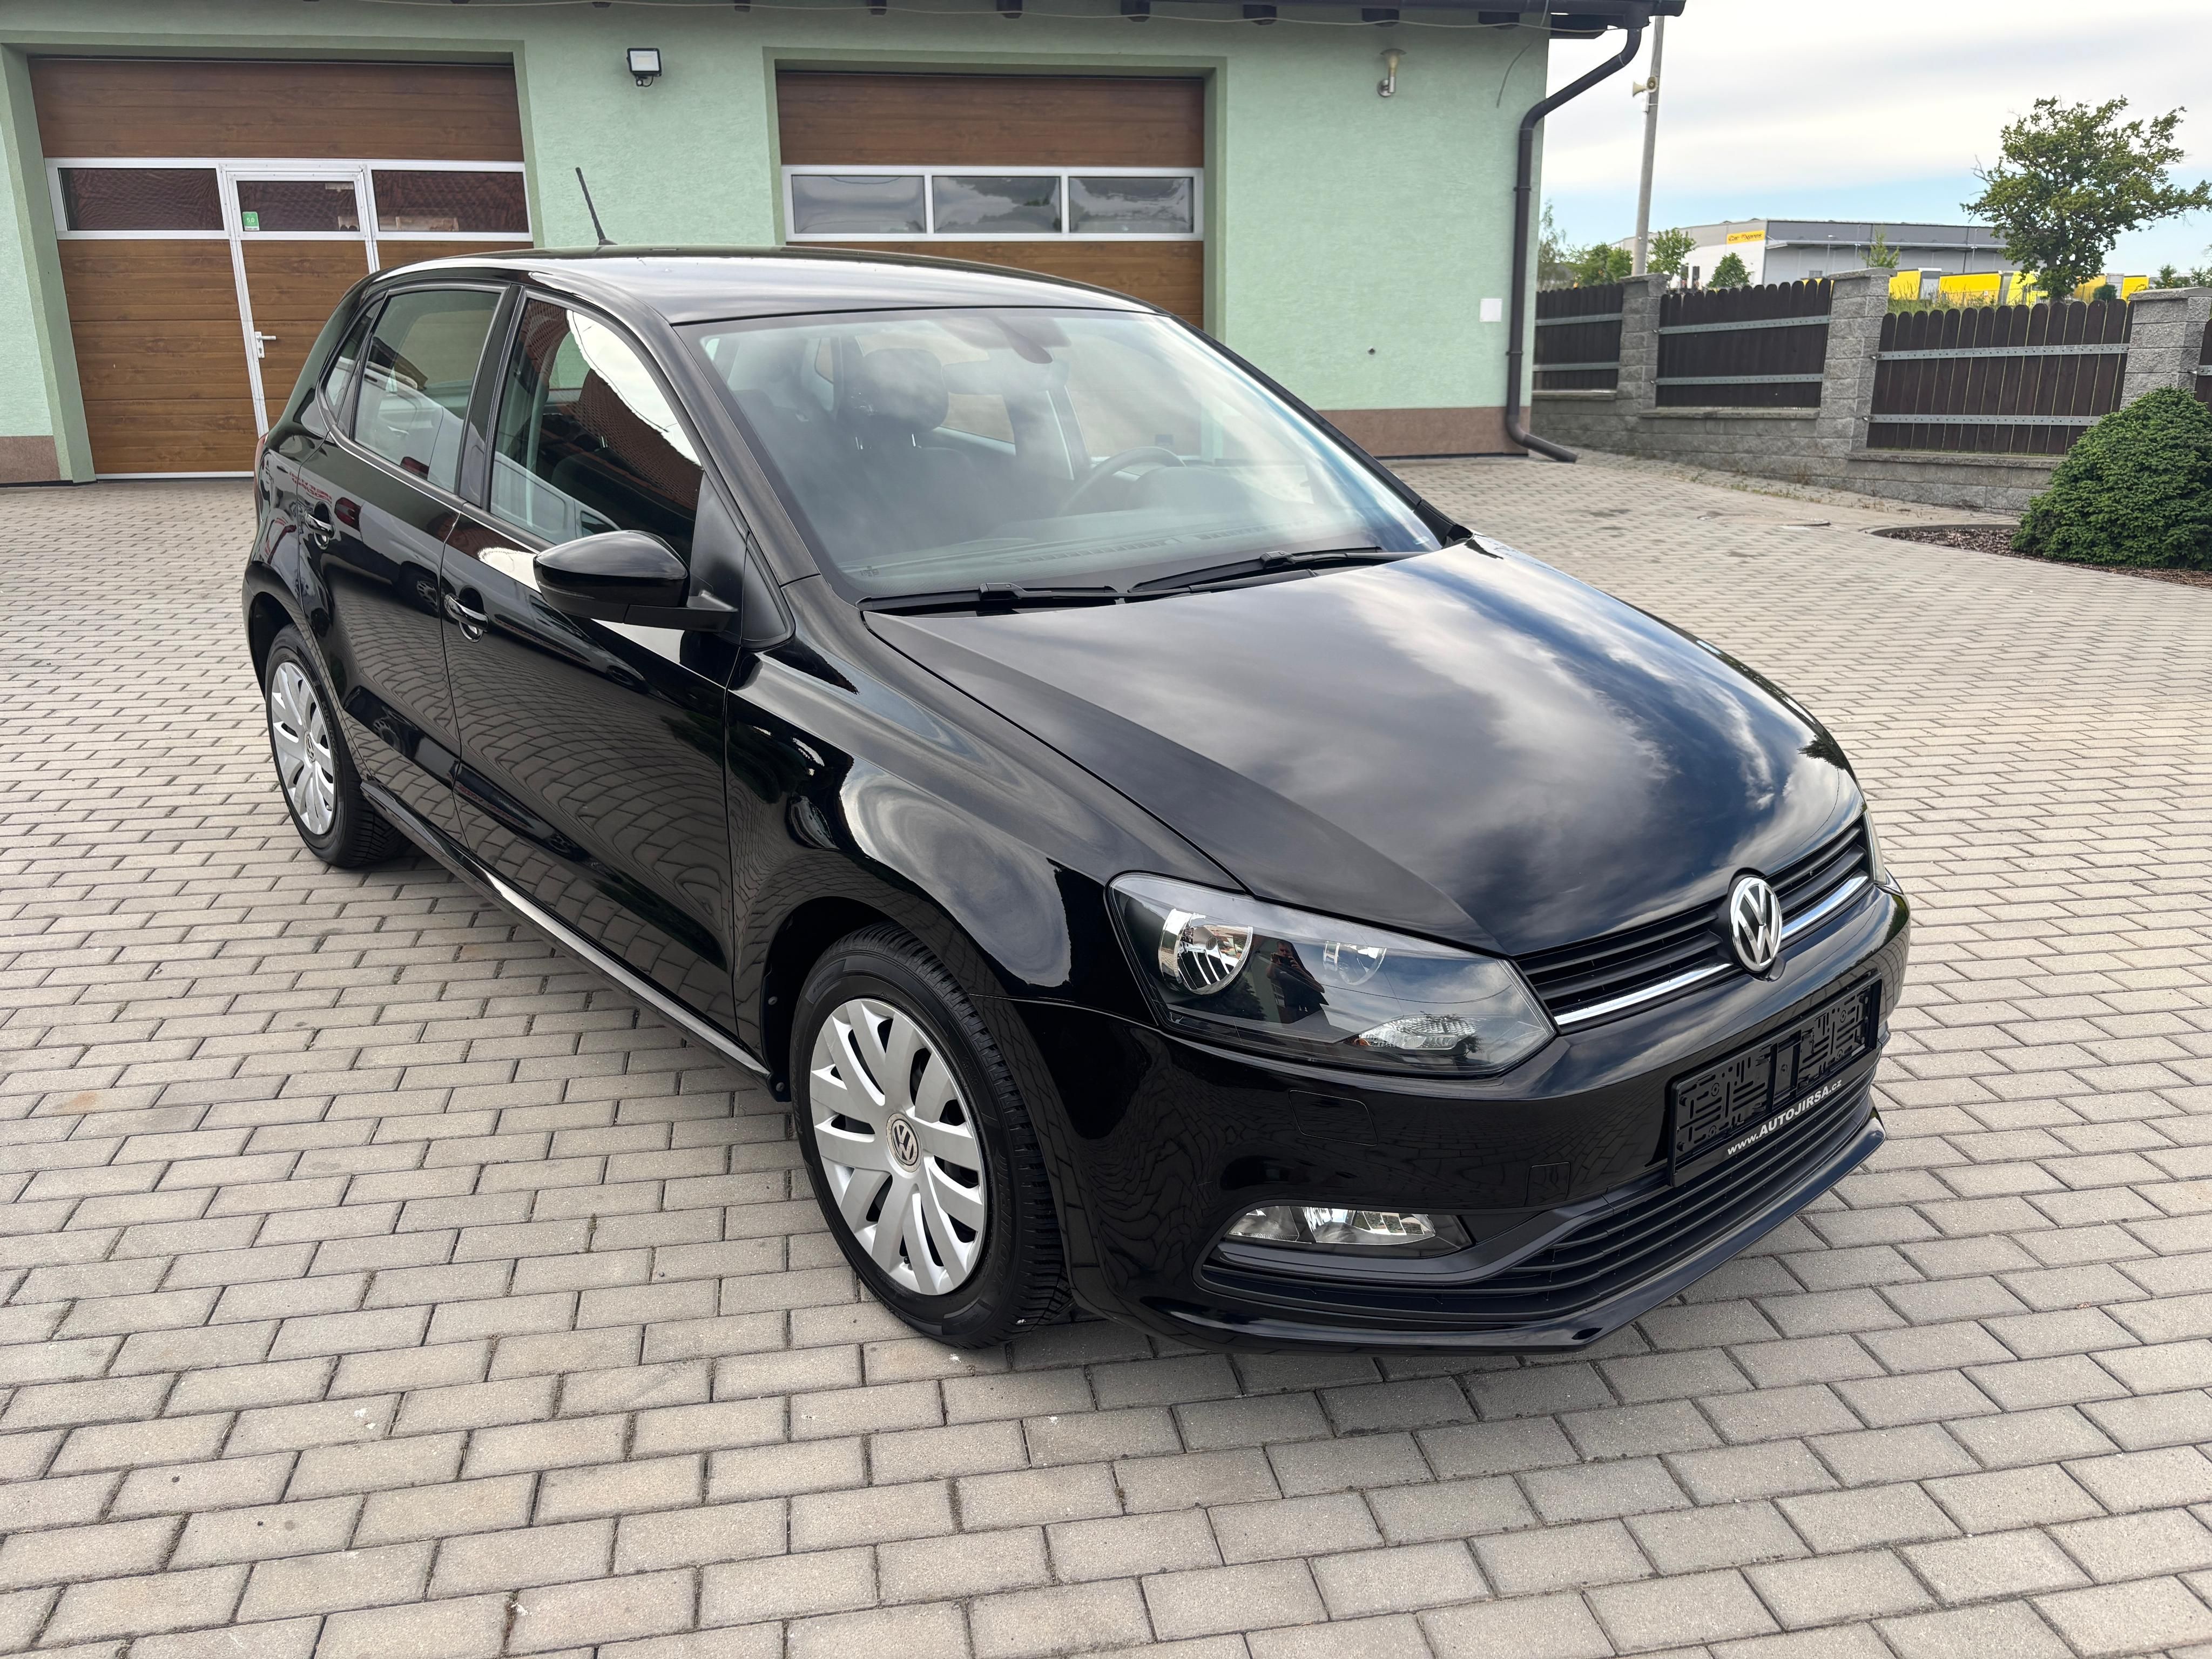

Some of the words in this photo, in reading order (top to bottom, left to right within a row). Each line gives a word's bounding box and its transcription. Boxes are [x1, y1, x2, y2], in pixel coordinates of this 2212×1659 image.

[1731, 878, 1782, 970] VW
[890, 1118, 919, 1166] VW
[1727, 1080, 1842, 1155] www.AUTOJIRSA.cz
